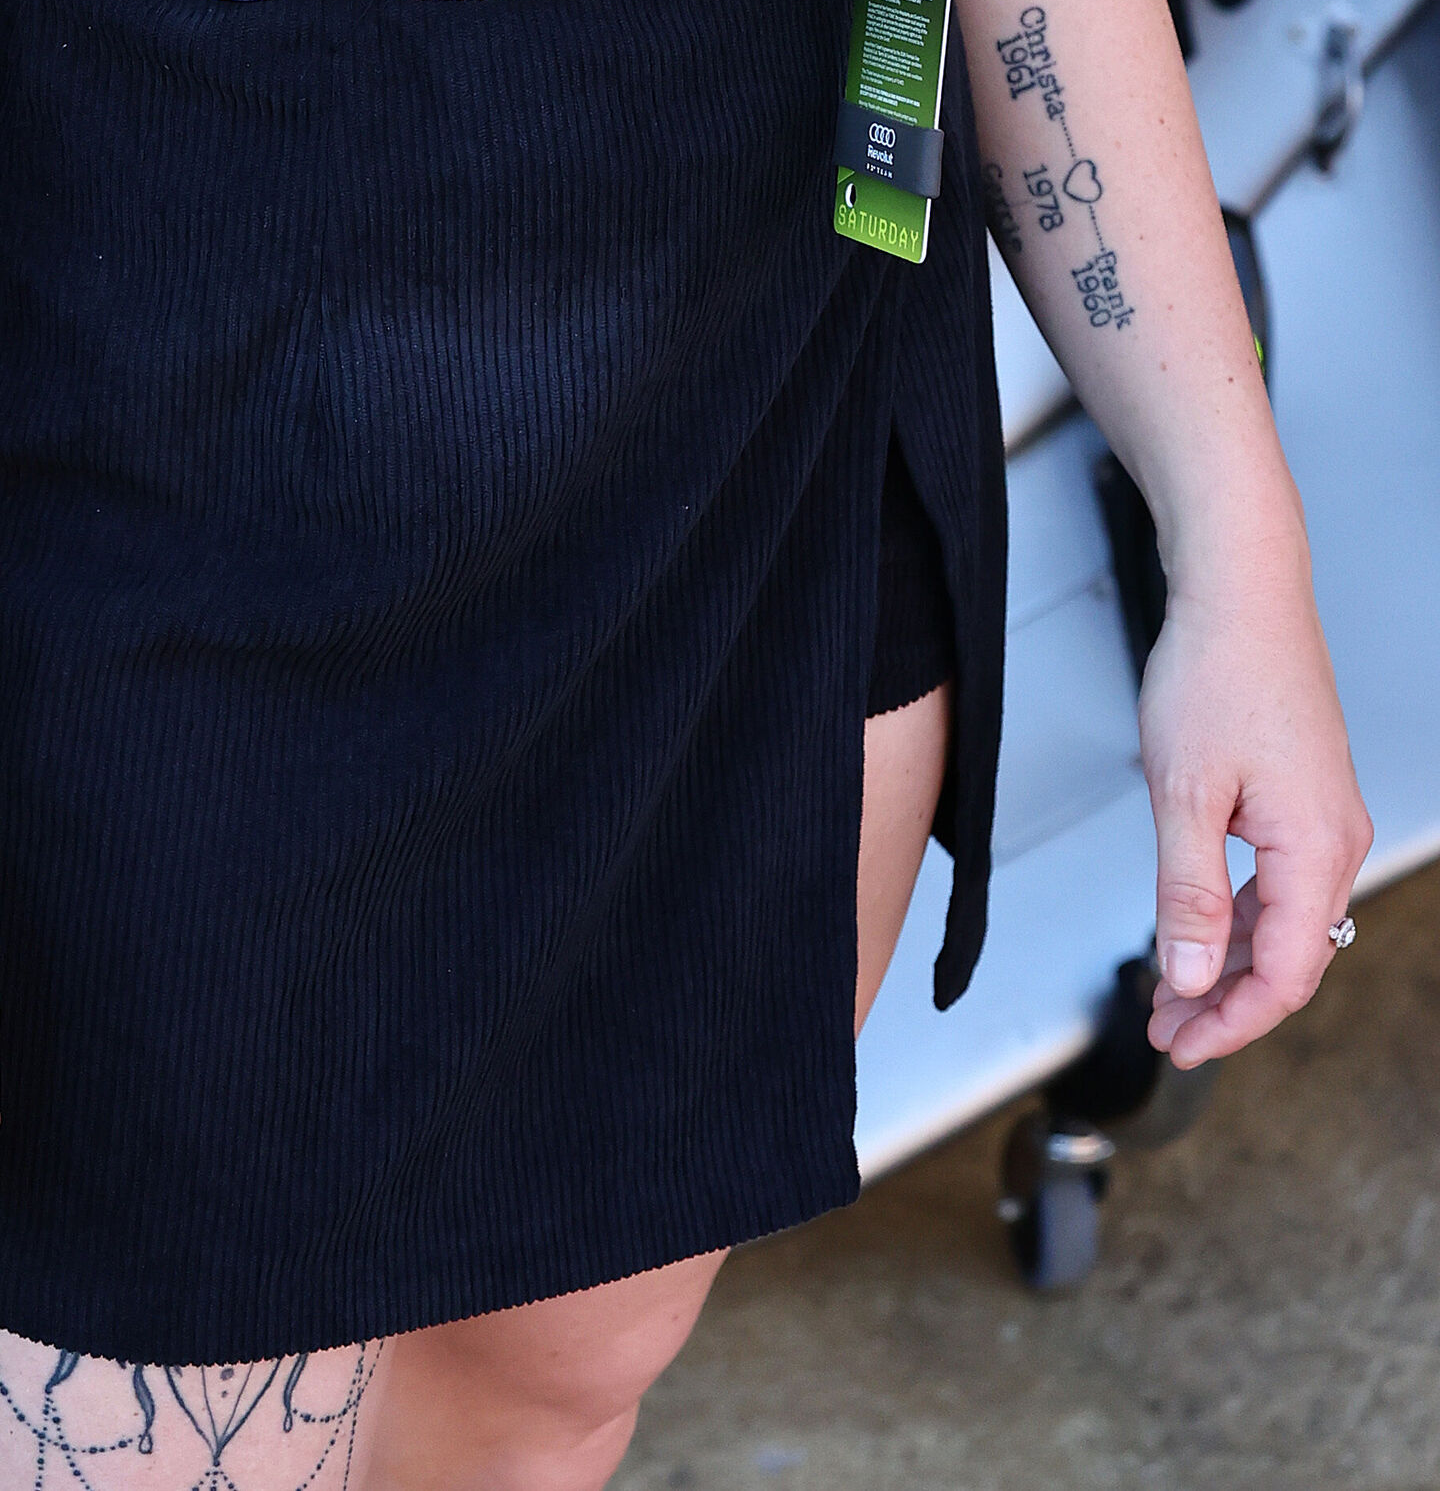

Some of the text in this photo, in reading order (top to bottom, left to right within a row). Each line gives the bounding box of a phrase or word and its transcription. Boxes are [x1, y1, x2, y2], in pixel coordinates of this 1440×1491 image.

[997, 32, 1036, 102] 1961
[1019, 6, 1066, 121] Christa
[837, 204, 920, 253] SATURDAY
[1022, 163, 1064, 233] 1978
[1071, 260, 1112, 328] 1960
[1095, 250, 1136, 331] Frank
